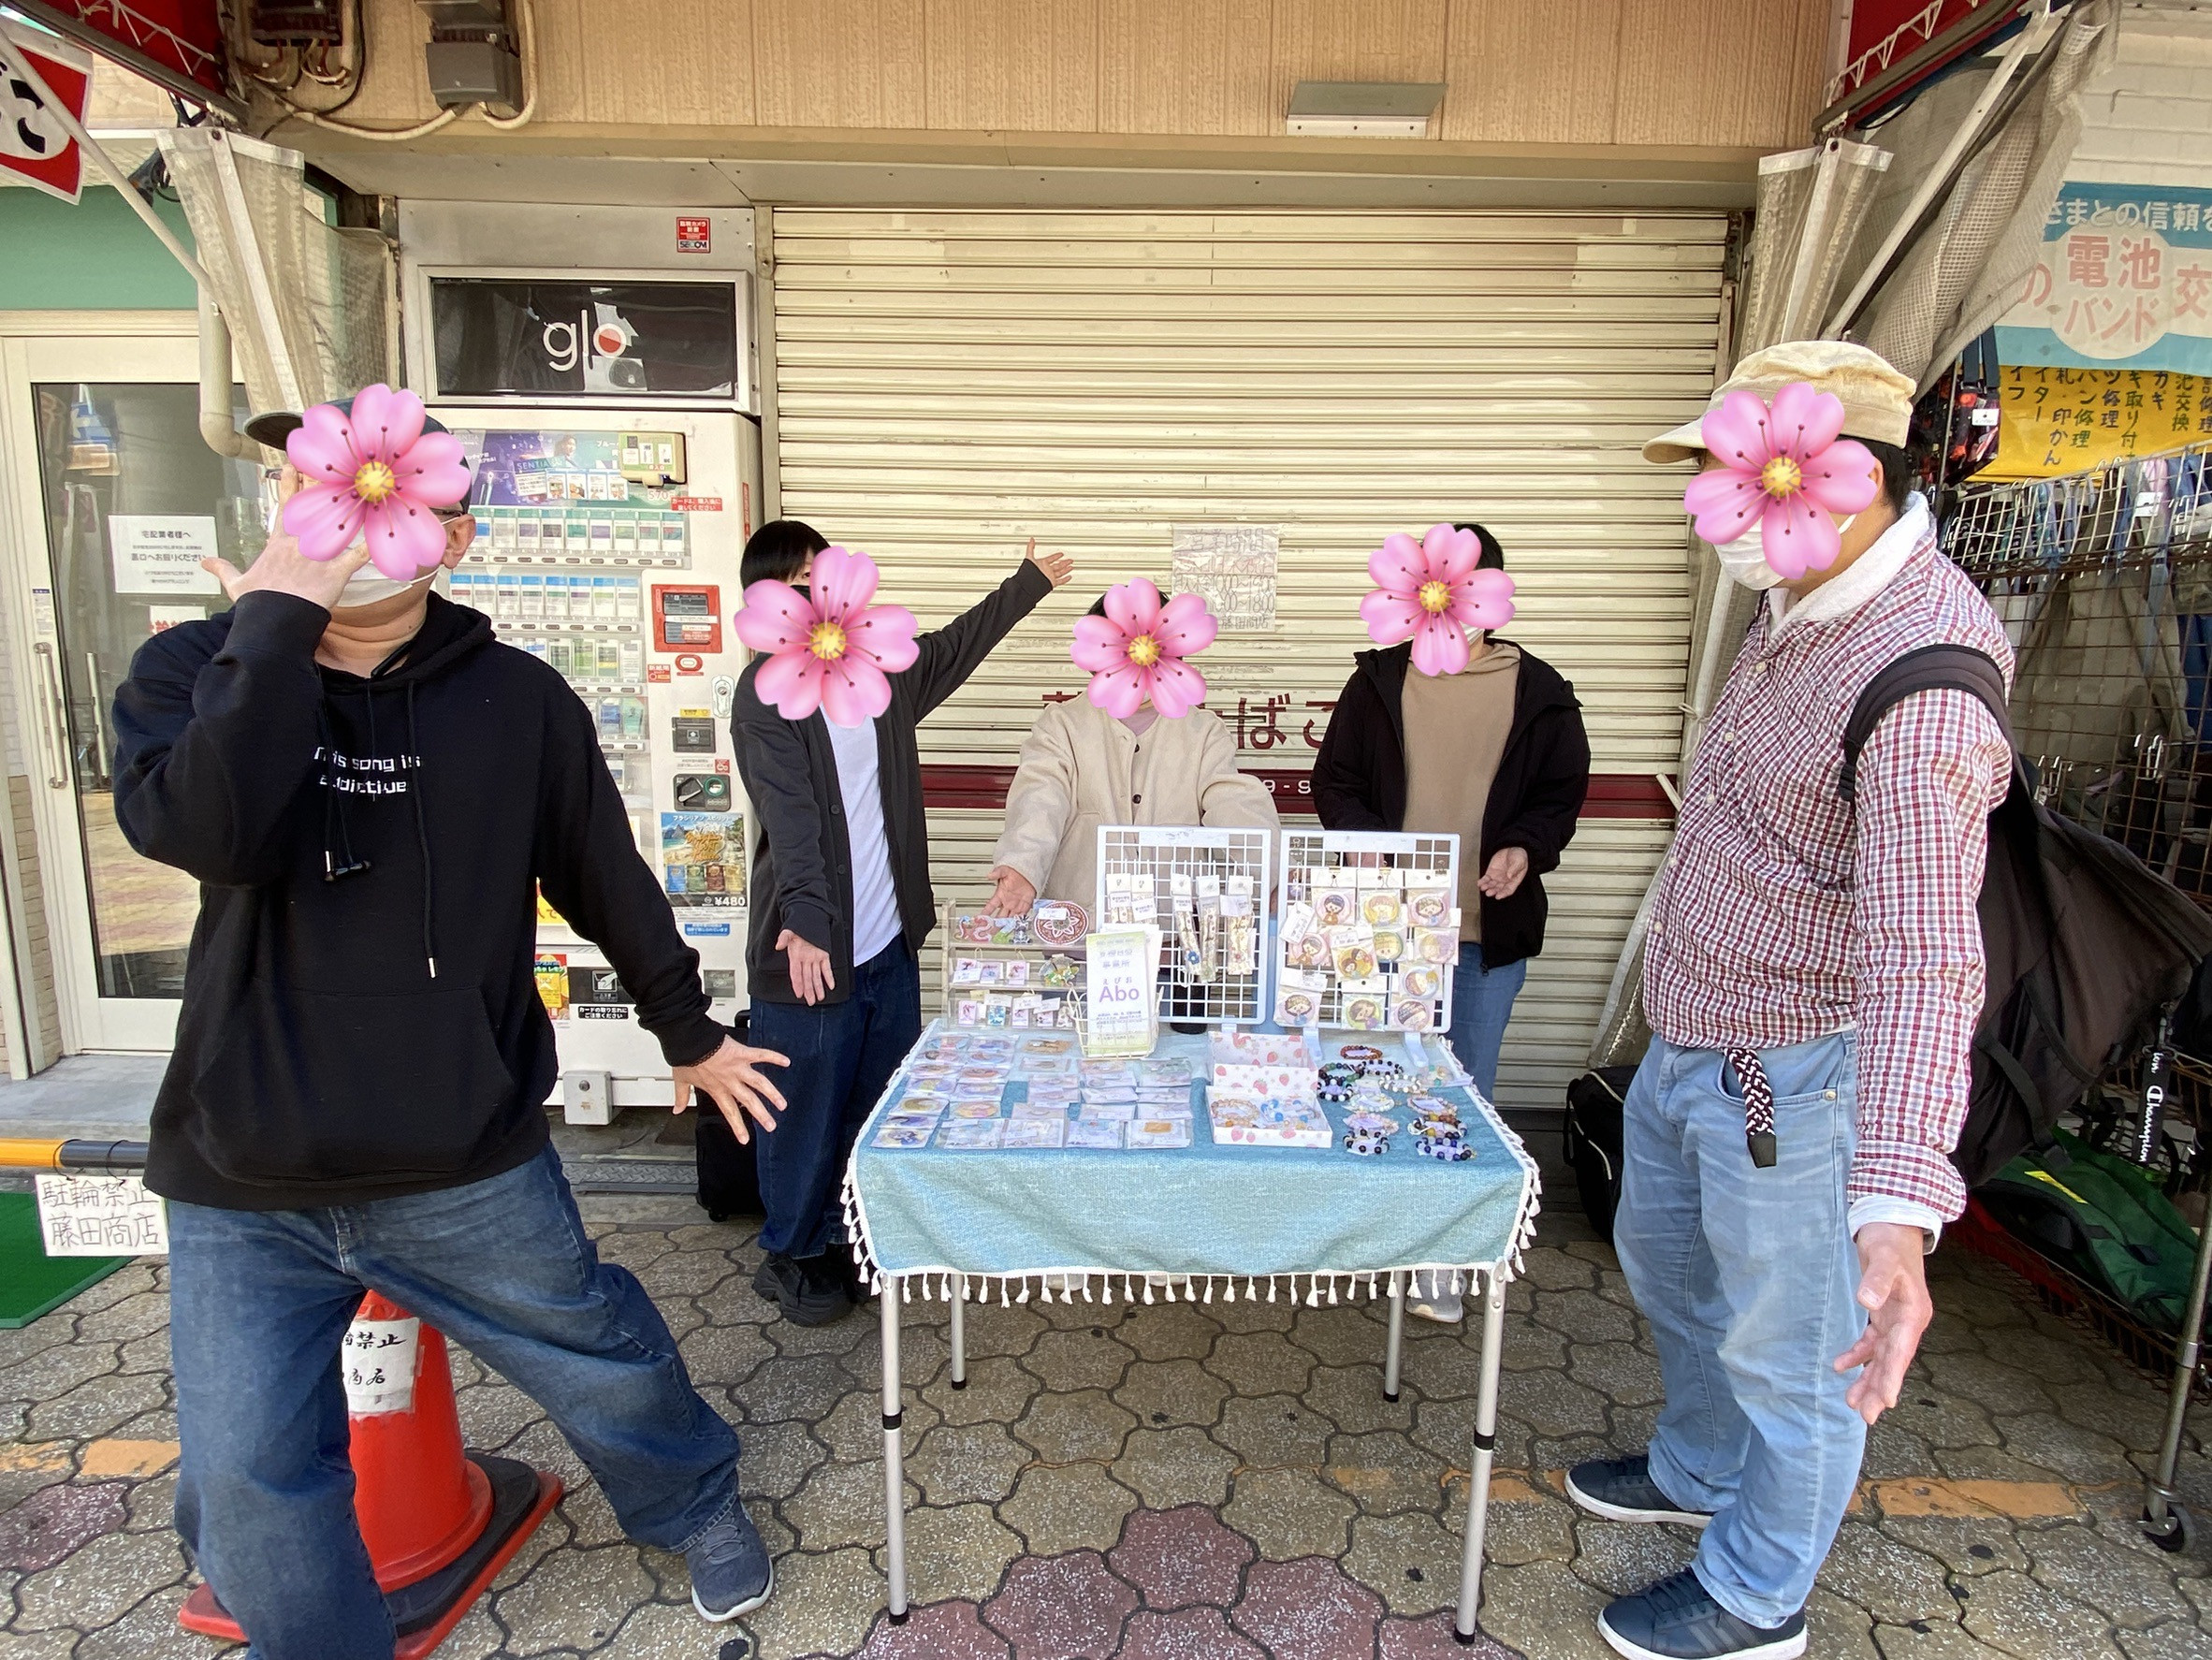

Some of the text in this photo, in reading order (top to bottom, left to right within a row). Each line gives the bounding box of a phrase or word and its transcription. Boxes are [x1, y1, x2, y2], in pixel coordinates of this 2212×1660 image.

[679, 240, 707, 249] SECOM
[2067, 235, 2161, 290] 電池
[2063, 295, 2160, 343] バンド
[543, 309, 627, 371] glo
[517, 459, 550, 470] SENTIA
[352, 758, 394, 772] song
[714, 896, 746, 907] ¥480
[1099, 984, 1140, 1003] Abo
[2137, 1085, 2164, 1162] Champion
[41, 1178, 159, 1208] 駐輪禁止
[47, 1212, 160, 1247] 藤田商店
